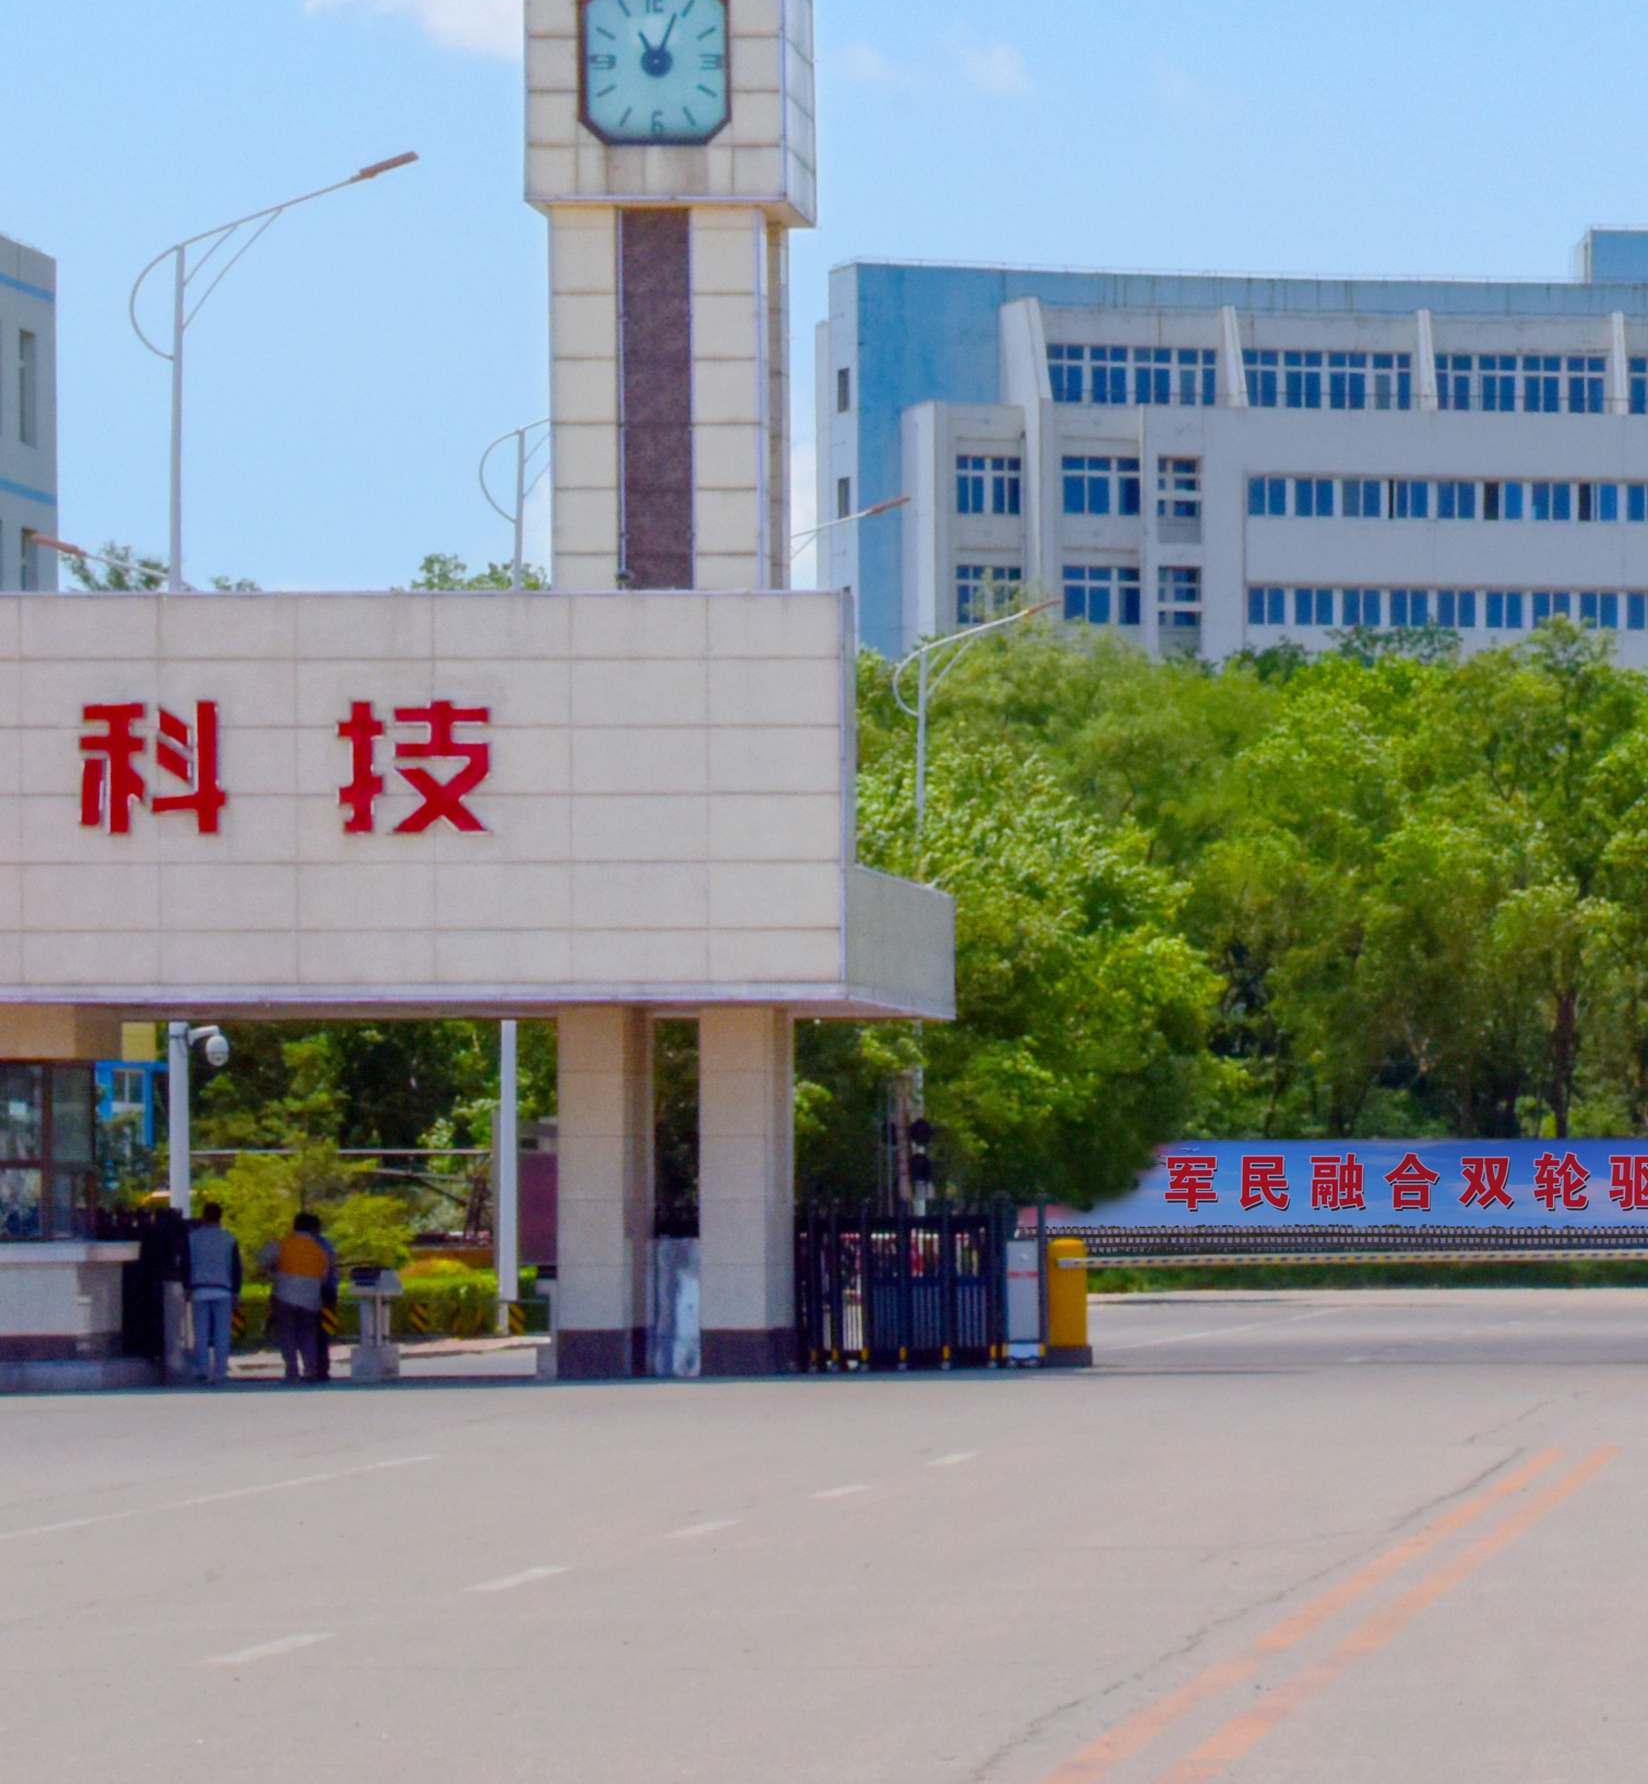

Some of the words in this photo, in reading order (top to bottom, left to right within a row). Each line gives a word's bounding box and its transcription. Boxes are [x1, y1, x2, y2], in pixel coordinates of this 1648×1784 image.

[590, 54, 616, 70] 9
[699, 54, 723, 70] 3
[651, 110, 664, 137] 6
